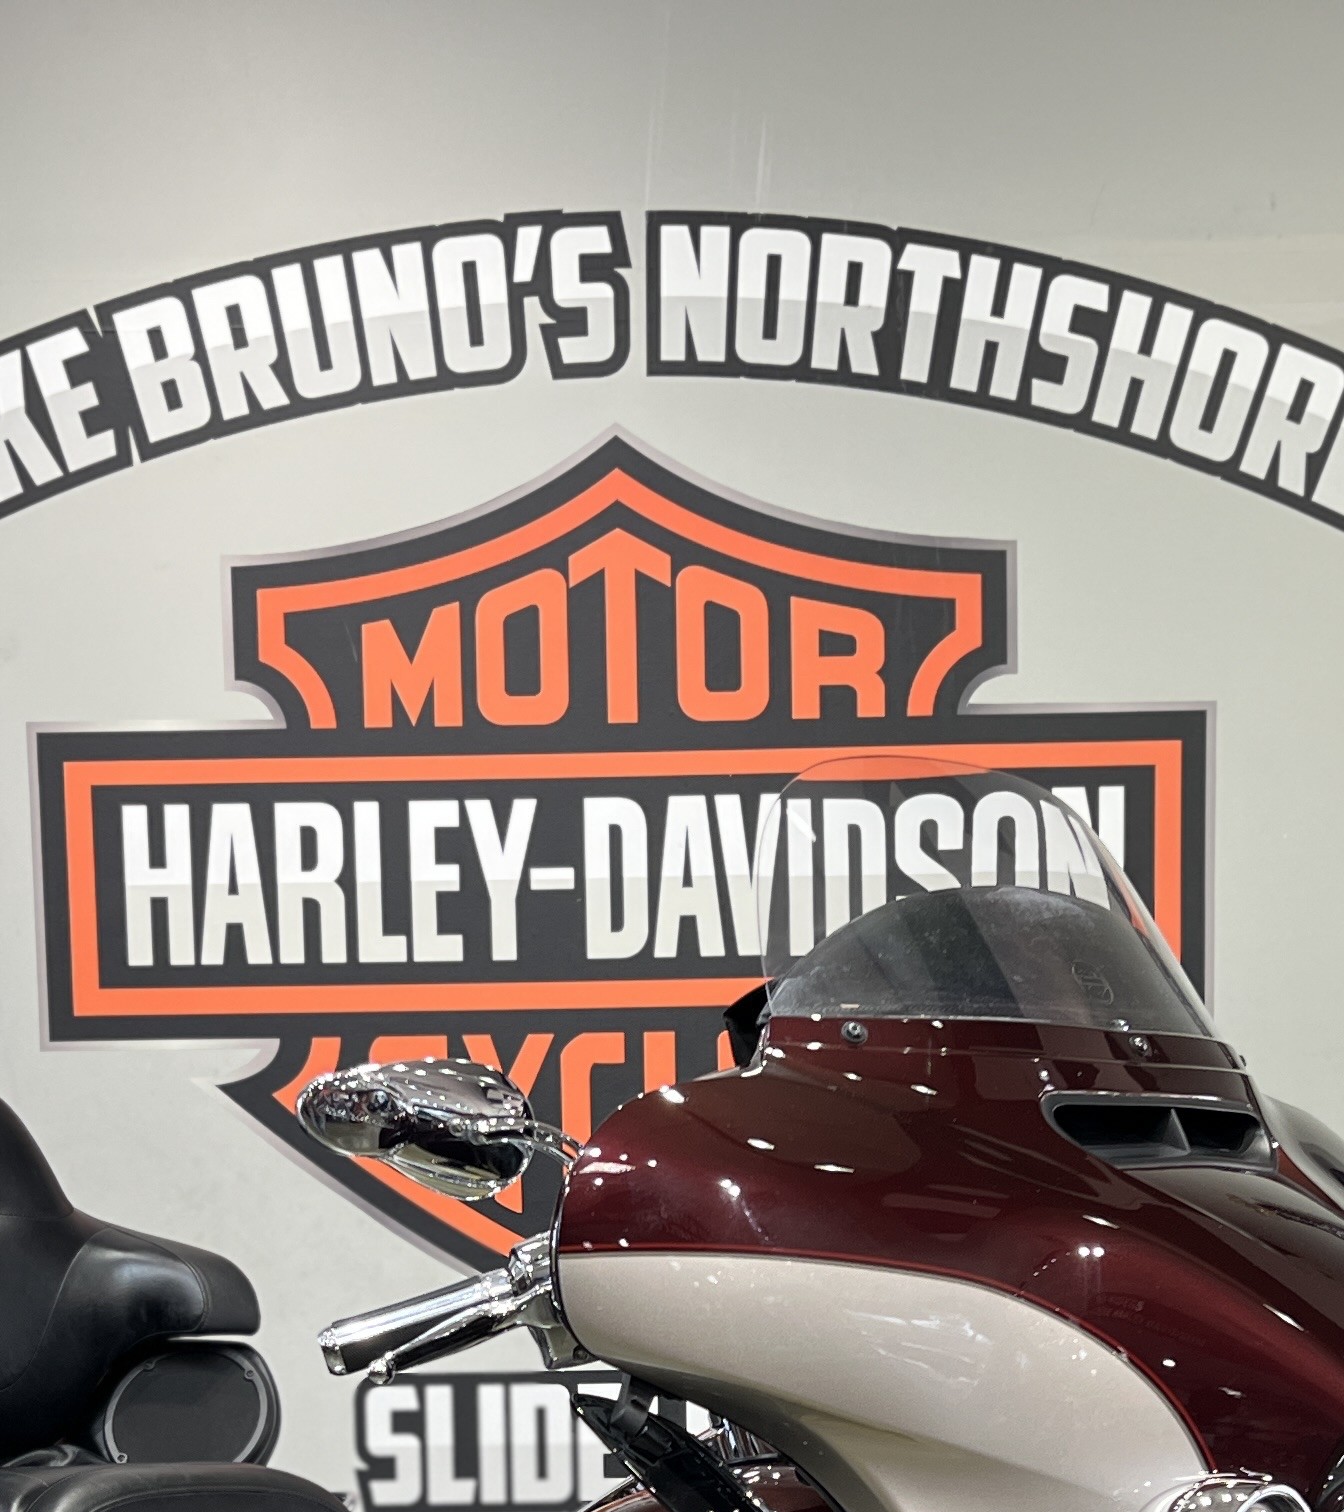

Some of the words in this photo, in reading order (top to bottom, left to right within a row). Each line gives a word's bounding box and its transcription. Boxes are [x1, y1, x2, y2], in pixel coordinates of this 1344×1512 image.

[112, 225, 615, 443] BRUNO'S
[360, 527, 887, 729] MOTOR
[120, 785, 1127, 968] HARLEY-DAVIDSON
[365, 1382, 712, 1506] SLIDE
